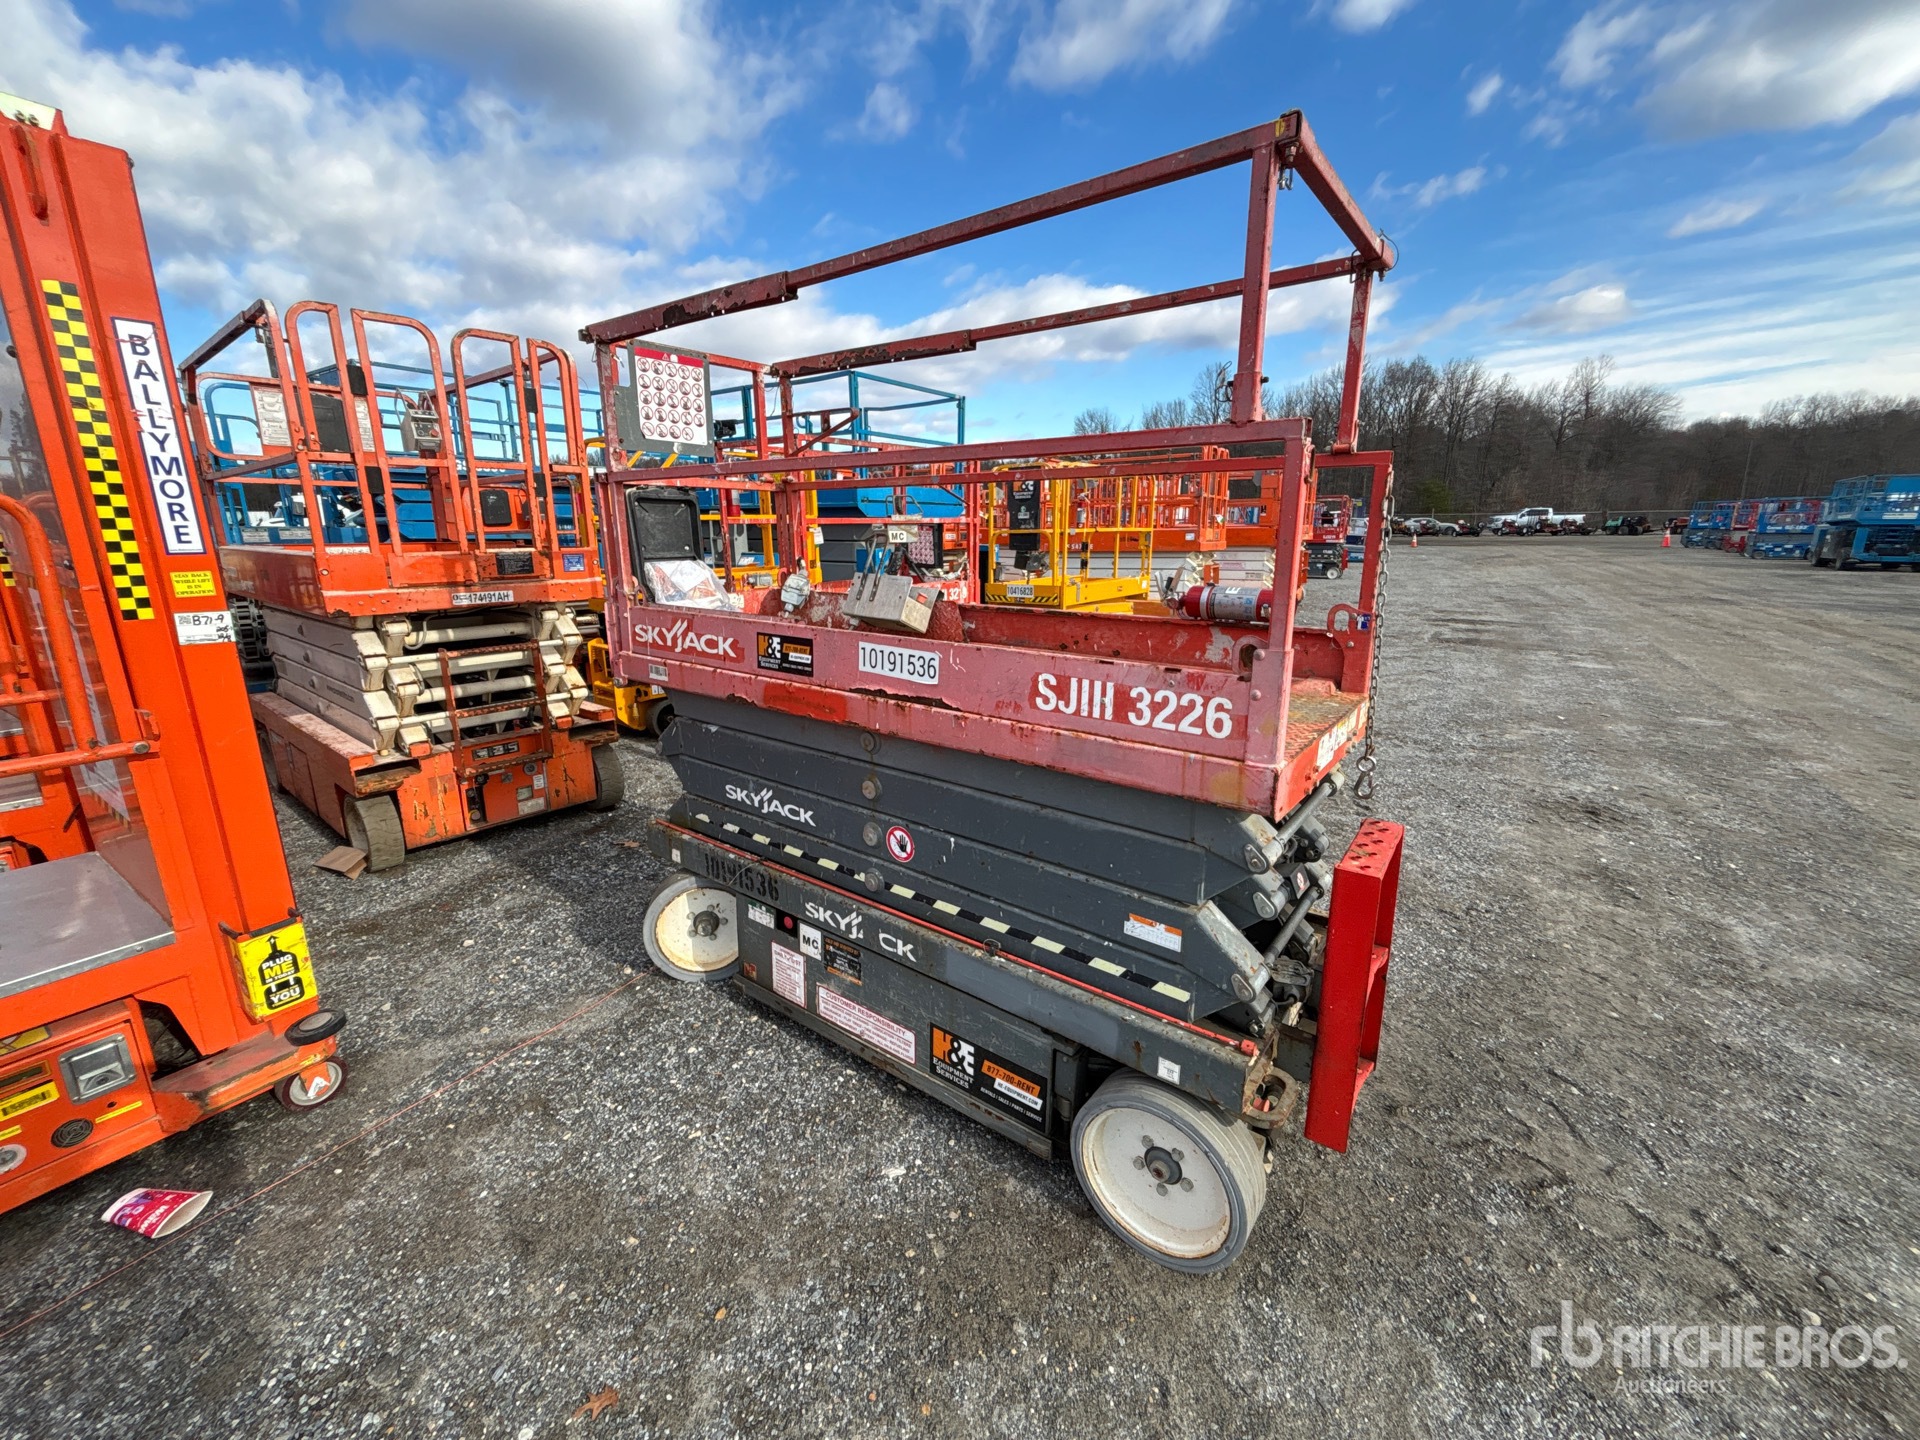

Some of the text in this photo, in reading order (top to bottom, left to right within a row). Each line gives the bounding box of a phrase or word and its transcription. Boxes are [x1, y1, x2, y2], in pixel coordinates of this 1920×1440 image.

[127, 333, 192, 544] BALLYMORE
[891, 532, 905, 541] MC
[635, 618, 737, 658] SKYJACK
[758, 634, 781, 658] H&E
[861, 647, 937, 679] 10191536
[1128, 687, 1233, 739] 3226
[725, 784, 816, 827] SKYJACK
[802, 934, 819, 950] MC
[261, 954, 293, 970] PLUG
[263, 961, 294, 979] ME
[274, 970, 295, 980] TODAY
[270, 986, 300, 1004] YOU
[826, 992, 856, 1011] CUSTOMER
[858, 1007, 906, 1036] RESPONSIBILITY
[932, 1027, 974, 1076] H&E
[932, 1057, 974, 1084] EQUIPMENT
[936, 1065, 970, 1089] SERVICES
[986, 1065, 1036, 1094] 877-700-RENT
